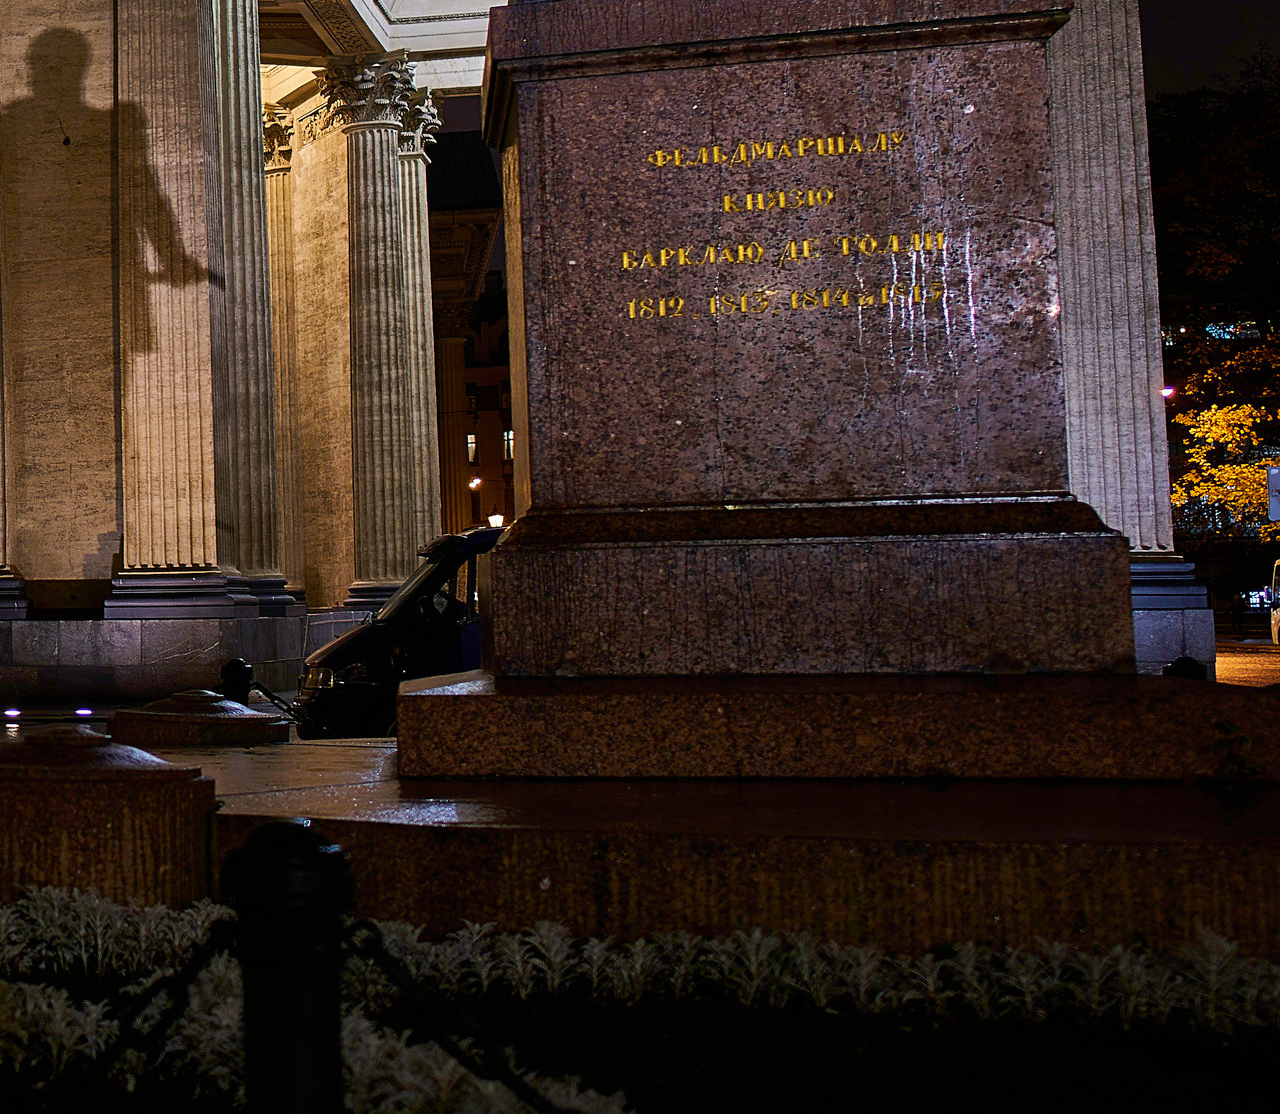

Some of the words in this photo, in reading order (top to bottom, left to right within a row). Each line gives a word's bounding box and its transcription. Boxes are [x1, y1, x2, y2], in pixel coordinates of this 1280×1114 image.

[648, 131, 906, 168] ФЕЛЬДМАРШАЛУ
[723, 188, 834, 213] КНЯЗЮ
[622, 241, 764, 270] БАРКЛАЮ
[779, 238, 819, 268] ДЕ
[834, 231, 944, 256] ТОЛЛИ
[791, 286, 850, 310] 1814
